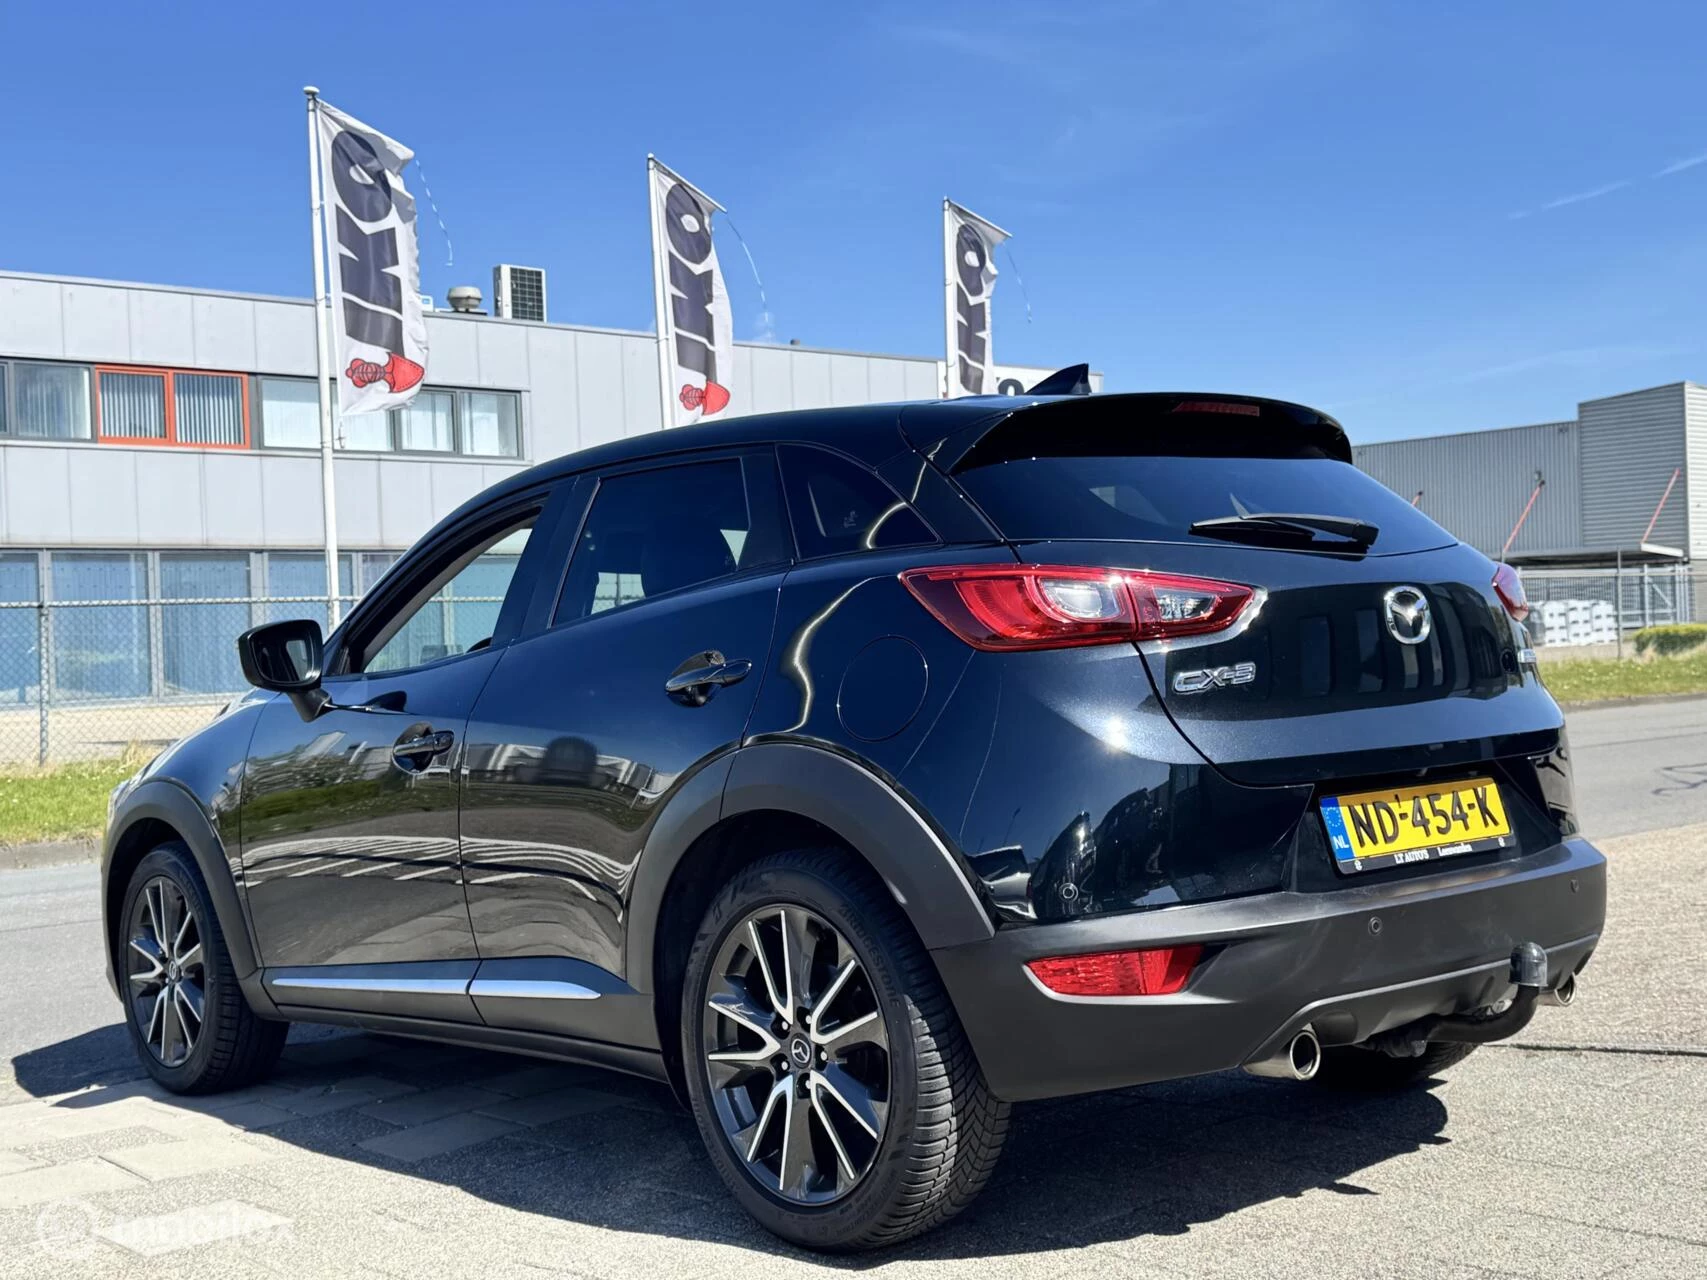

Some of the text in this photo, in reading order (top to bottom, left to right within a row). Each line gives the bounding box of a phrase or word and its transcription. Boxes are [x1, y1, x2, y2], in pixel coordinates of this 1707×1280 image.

[1172, 662, 1256, 695] CX-3
[1348, 787, 1499, 848] ND-454-K
[1333, 835, 1349, 849] NL
